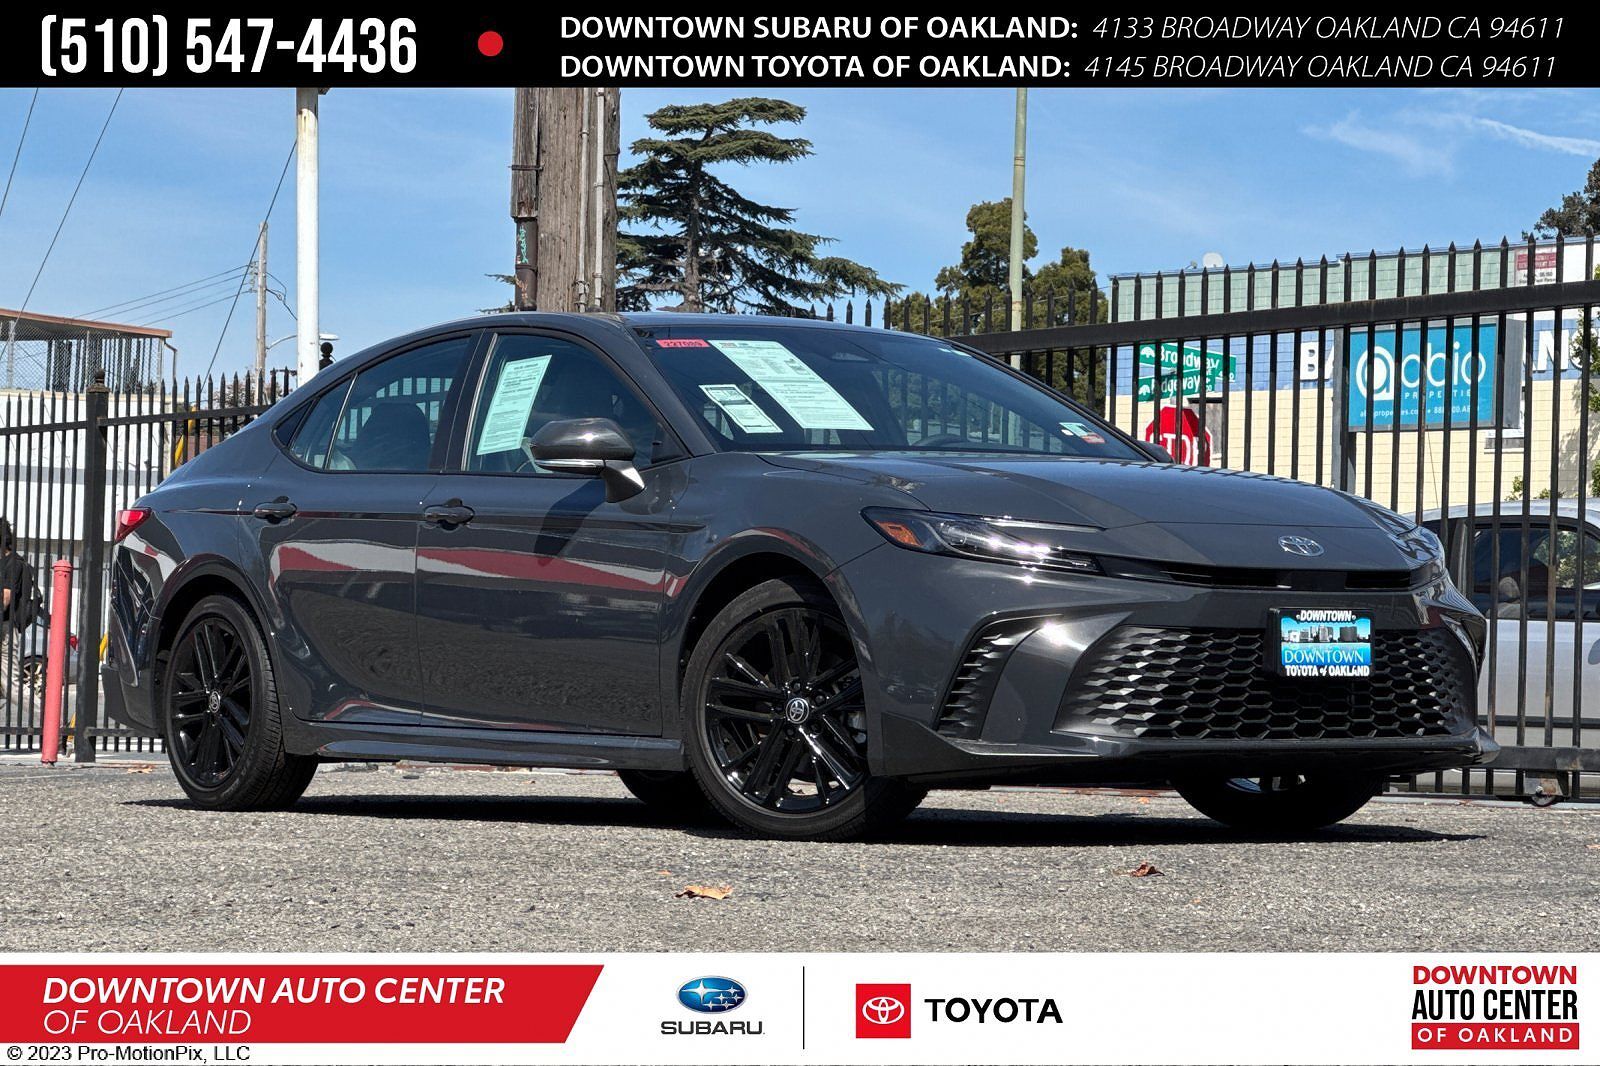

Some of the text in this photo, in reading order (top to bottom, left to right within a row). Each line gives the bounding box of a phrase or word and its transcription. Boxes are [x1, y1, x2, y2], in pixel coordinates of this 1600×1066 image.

[1300, 610, 1352, 621] DOWNTOWN
[1284, 649, 1364, 663] DOWNTOWN
[1285, 665, 1319, 676] TOYOTA
[1329, 665, 1370, 676] OAKLAND
